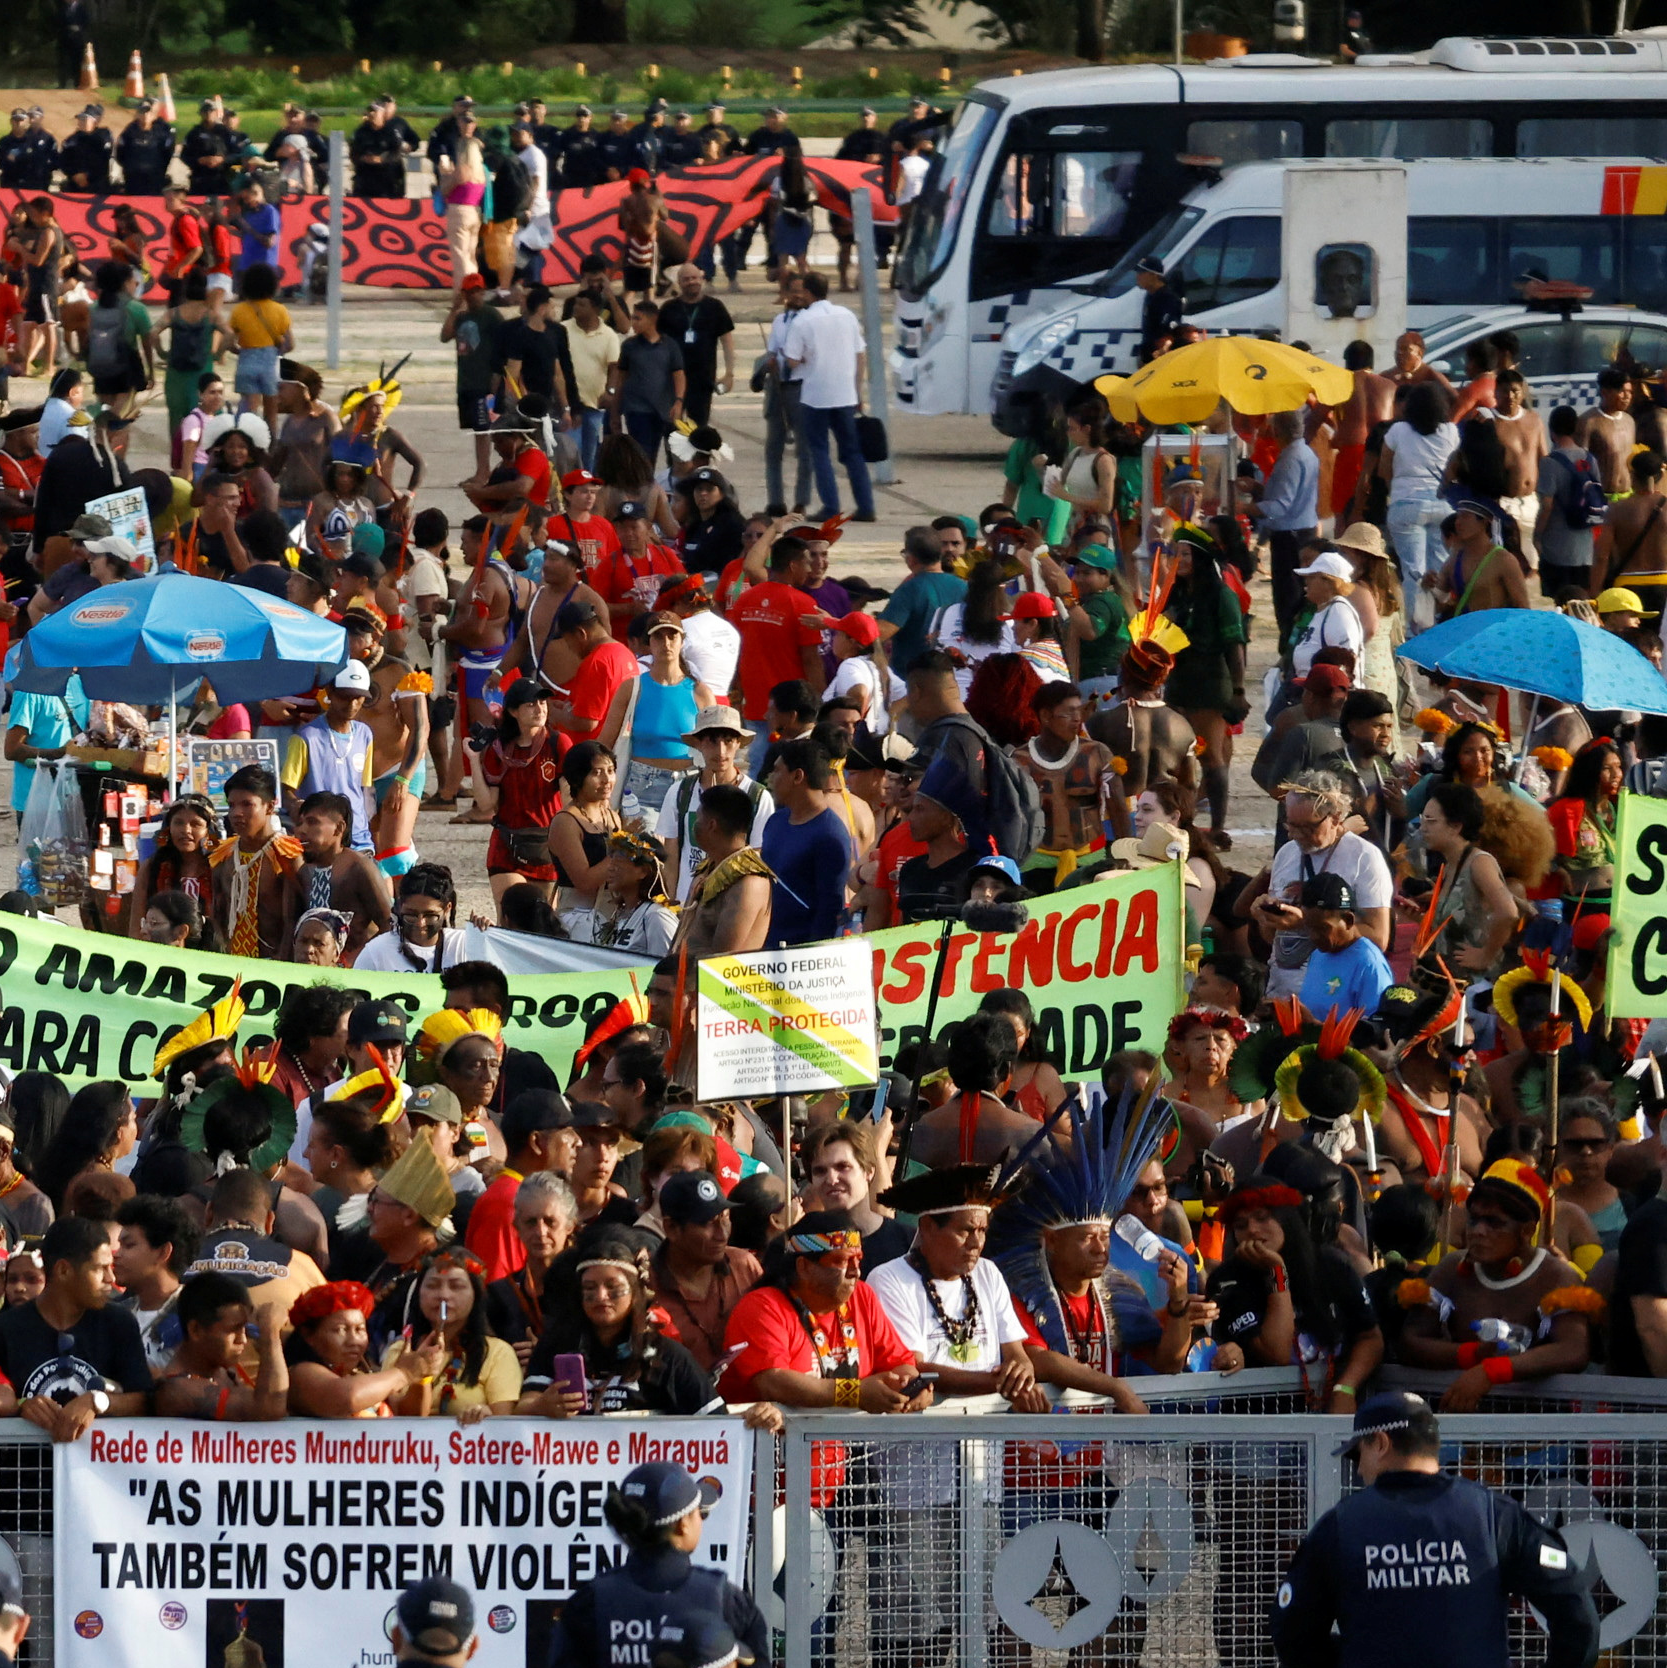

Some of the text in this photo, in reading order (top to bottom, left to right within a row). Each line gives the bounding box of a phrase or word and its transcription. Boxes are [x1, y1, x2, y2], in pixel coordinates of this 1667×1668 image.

[722, 955, 847, 980] GOVERNO FEDERAL
[724, 975, 846, 997] MINISTÉRIO DA JUSTIÇA
[703, 988, 867, 1014] Fundação Nacional dos Povos Indígenas
[704, 1007, 868, 1039] TERRA PROTEGIDA
[794, 1041, 826, 1052] PESSOAS
[90, 1429, 729, 1474] Rede de Mulheres Munduruku, Satere-Mawe e Maraguá
[128, 1478, 446, 1528] "AS MULHERES
[91, 1532, 454, 1592] TAMBÉM SOFREM
[1365, 1538, 1467, 1566] POLÍCIA
[1366, 1564, 1471, 1590] MILITAR
